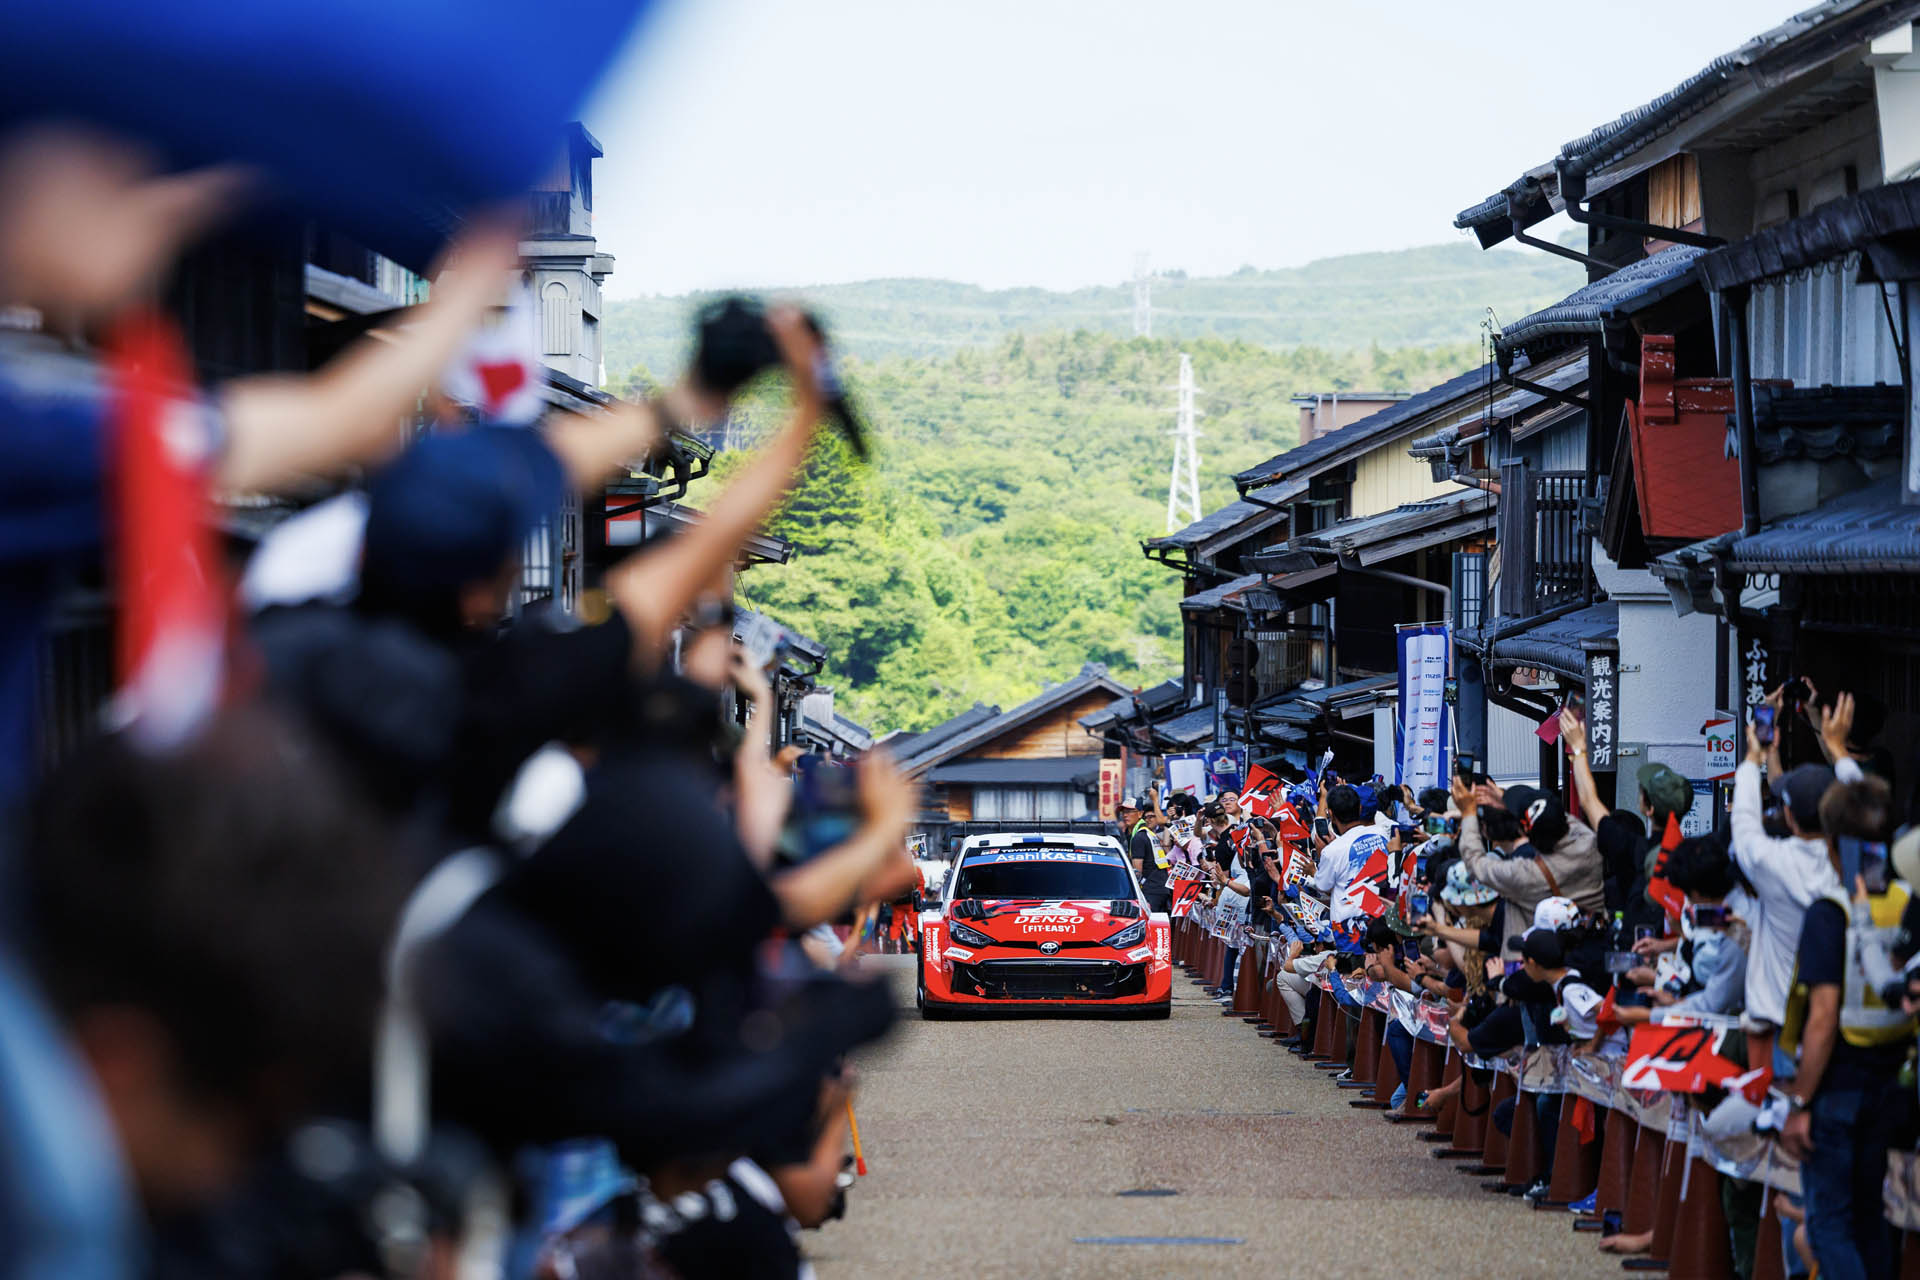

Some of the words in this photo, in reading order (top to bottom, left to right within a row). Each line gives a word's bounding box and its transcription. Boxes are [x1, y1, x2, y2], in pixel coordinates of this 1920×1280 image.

[1591, 655, 1612, 764] 観光案内所
[1014, 915, 1085, 924] DENSO
